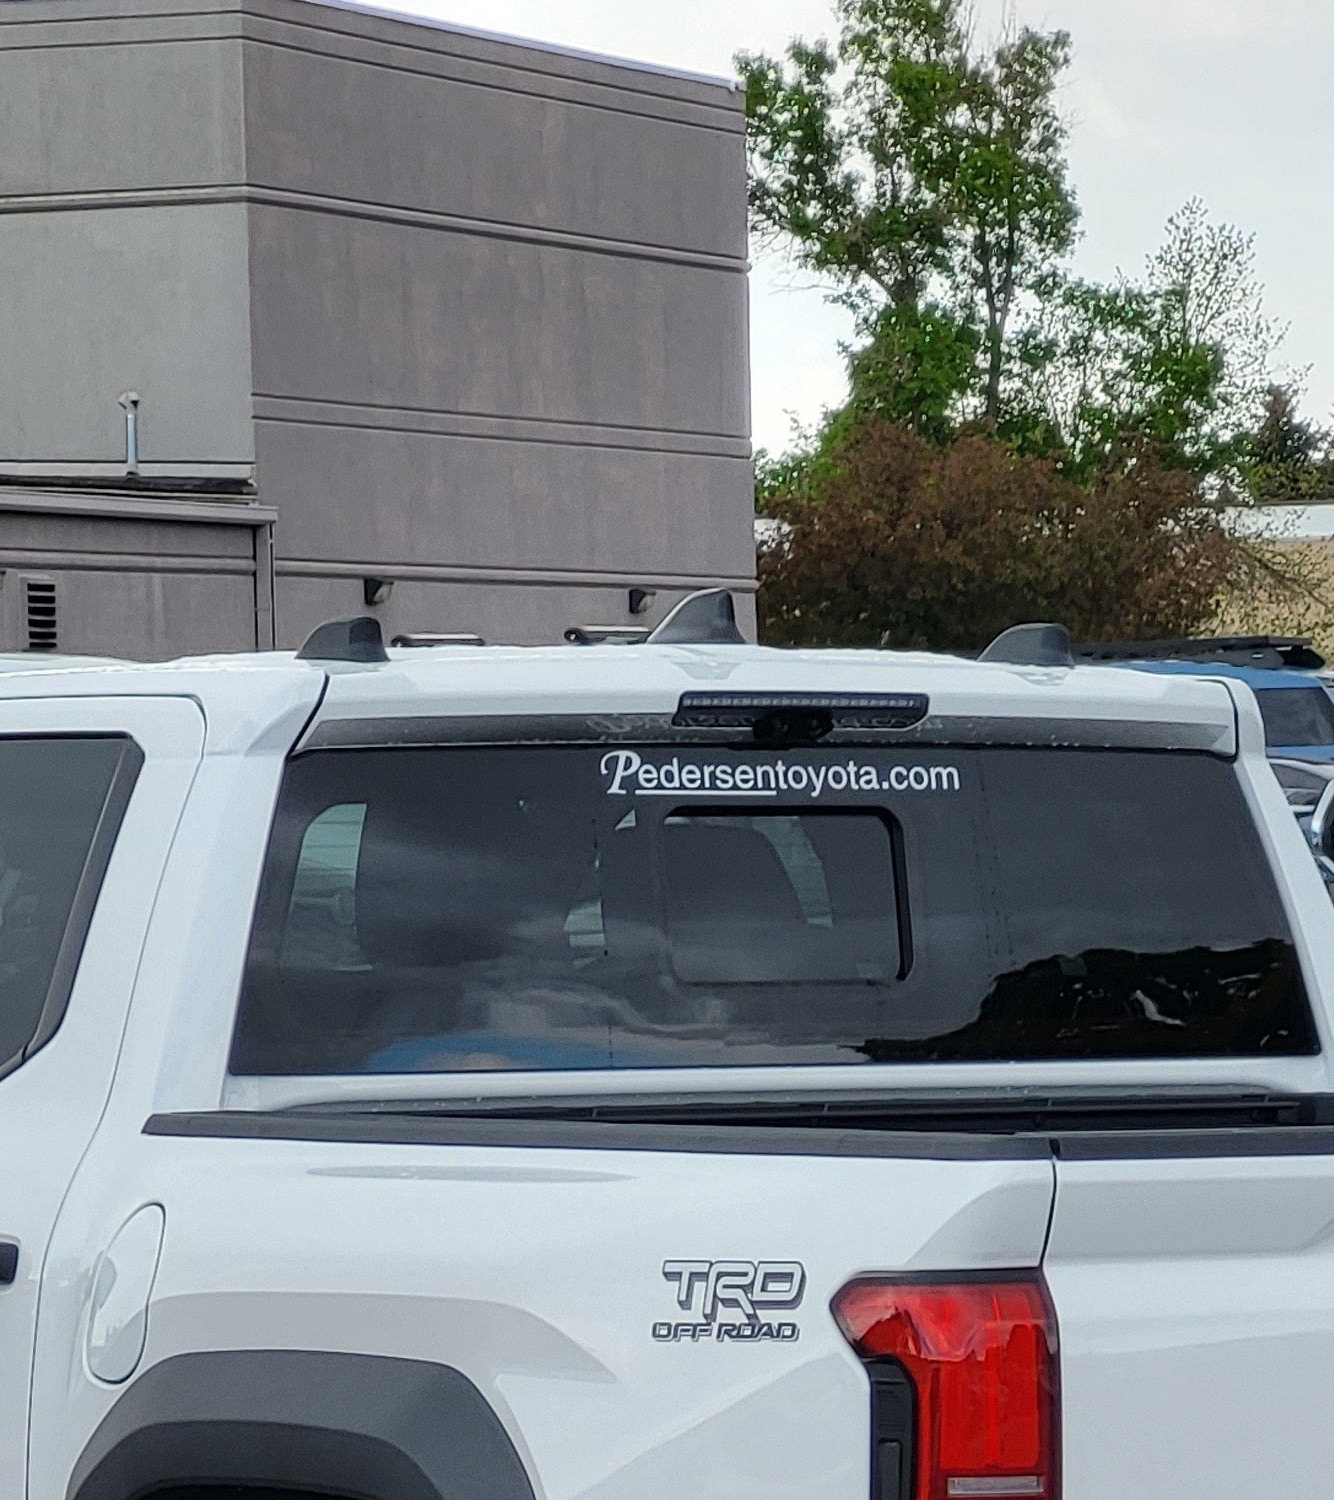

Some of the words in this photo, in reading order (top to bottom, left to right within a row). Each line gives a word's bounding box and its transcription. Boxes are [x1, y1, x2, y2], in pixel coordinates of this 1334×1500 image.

[600, 750, 961, 797] Pedersentoyota.com
[662, 1259, 807, 1327] TRD
[652, 1321, 713, 1343] OFF
[717, 1321, 800, 1343] ROAD
